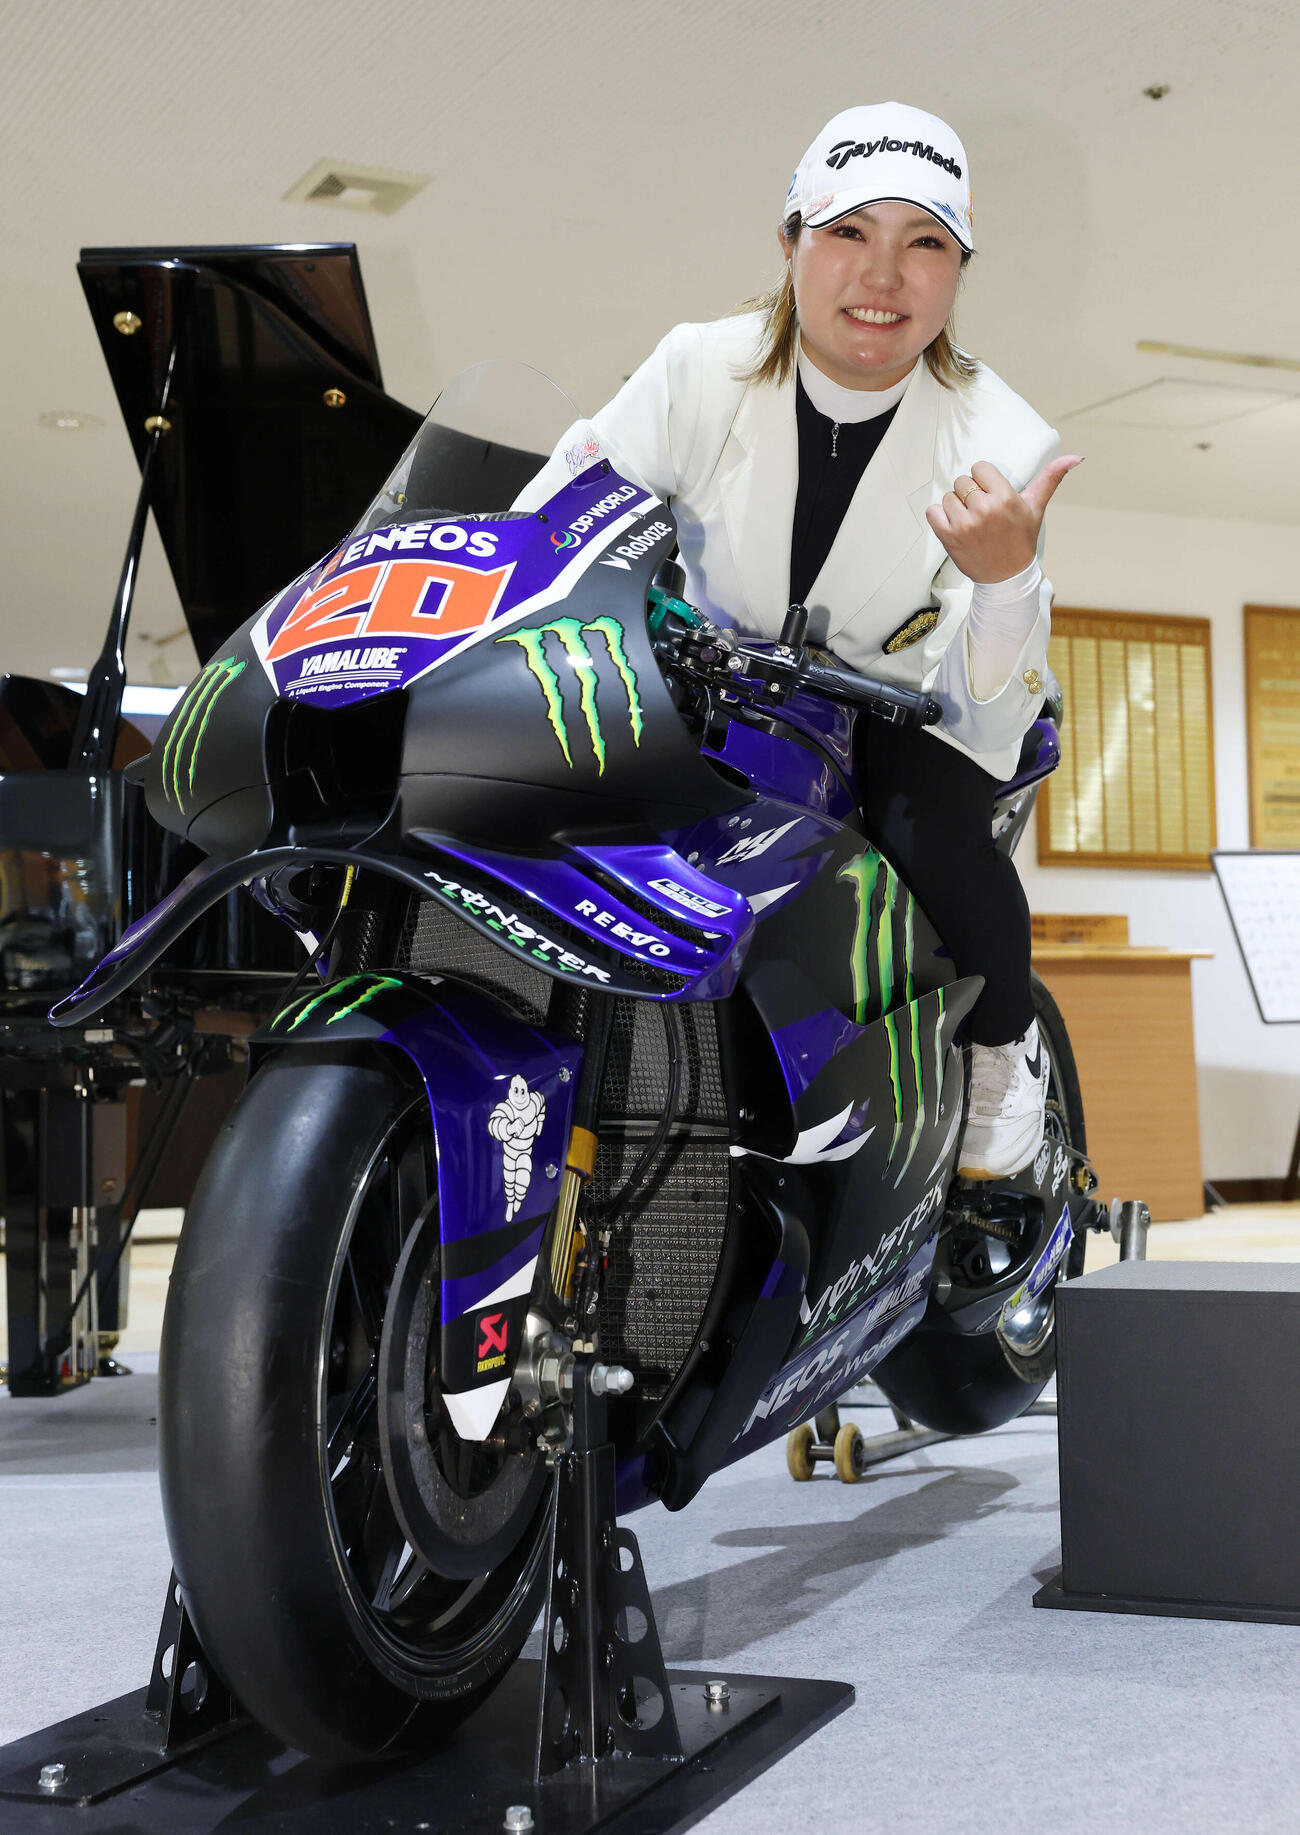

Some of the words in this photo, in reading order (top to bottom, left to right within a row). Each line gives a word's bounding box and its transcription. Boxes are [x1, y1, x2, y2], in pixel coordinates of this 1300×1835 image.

[826, 136, 962, 180] TaylorMade
[568, 511, 596, 534] DP
[590, 485, 638, 518] WORLD
[340, 524, 499, 568] ENEOS
[615, 521, 673, 560] Roboze
[264, 558, 518, 662] 20
[296, 685, 317, 696] Liquid
[318, 682, 343, 692] Engine
[344, 681, 390, 689] Component
[300, 647, 401, 678] YAMALUBE
[423, 871, 611, 984] MONSTER
[440, 887, 577, 972] ENERGY
[574, 899, 671, 957] REEVO
[844, 1317, 915, 1377] WORLD
[732, 1330, 850, 1443] NEOS
